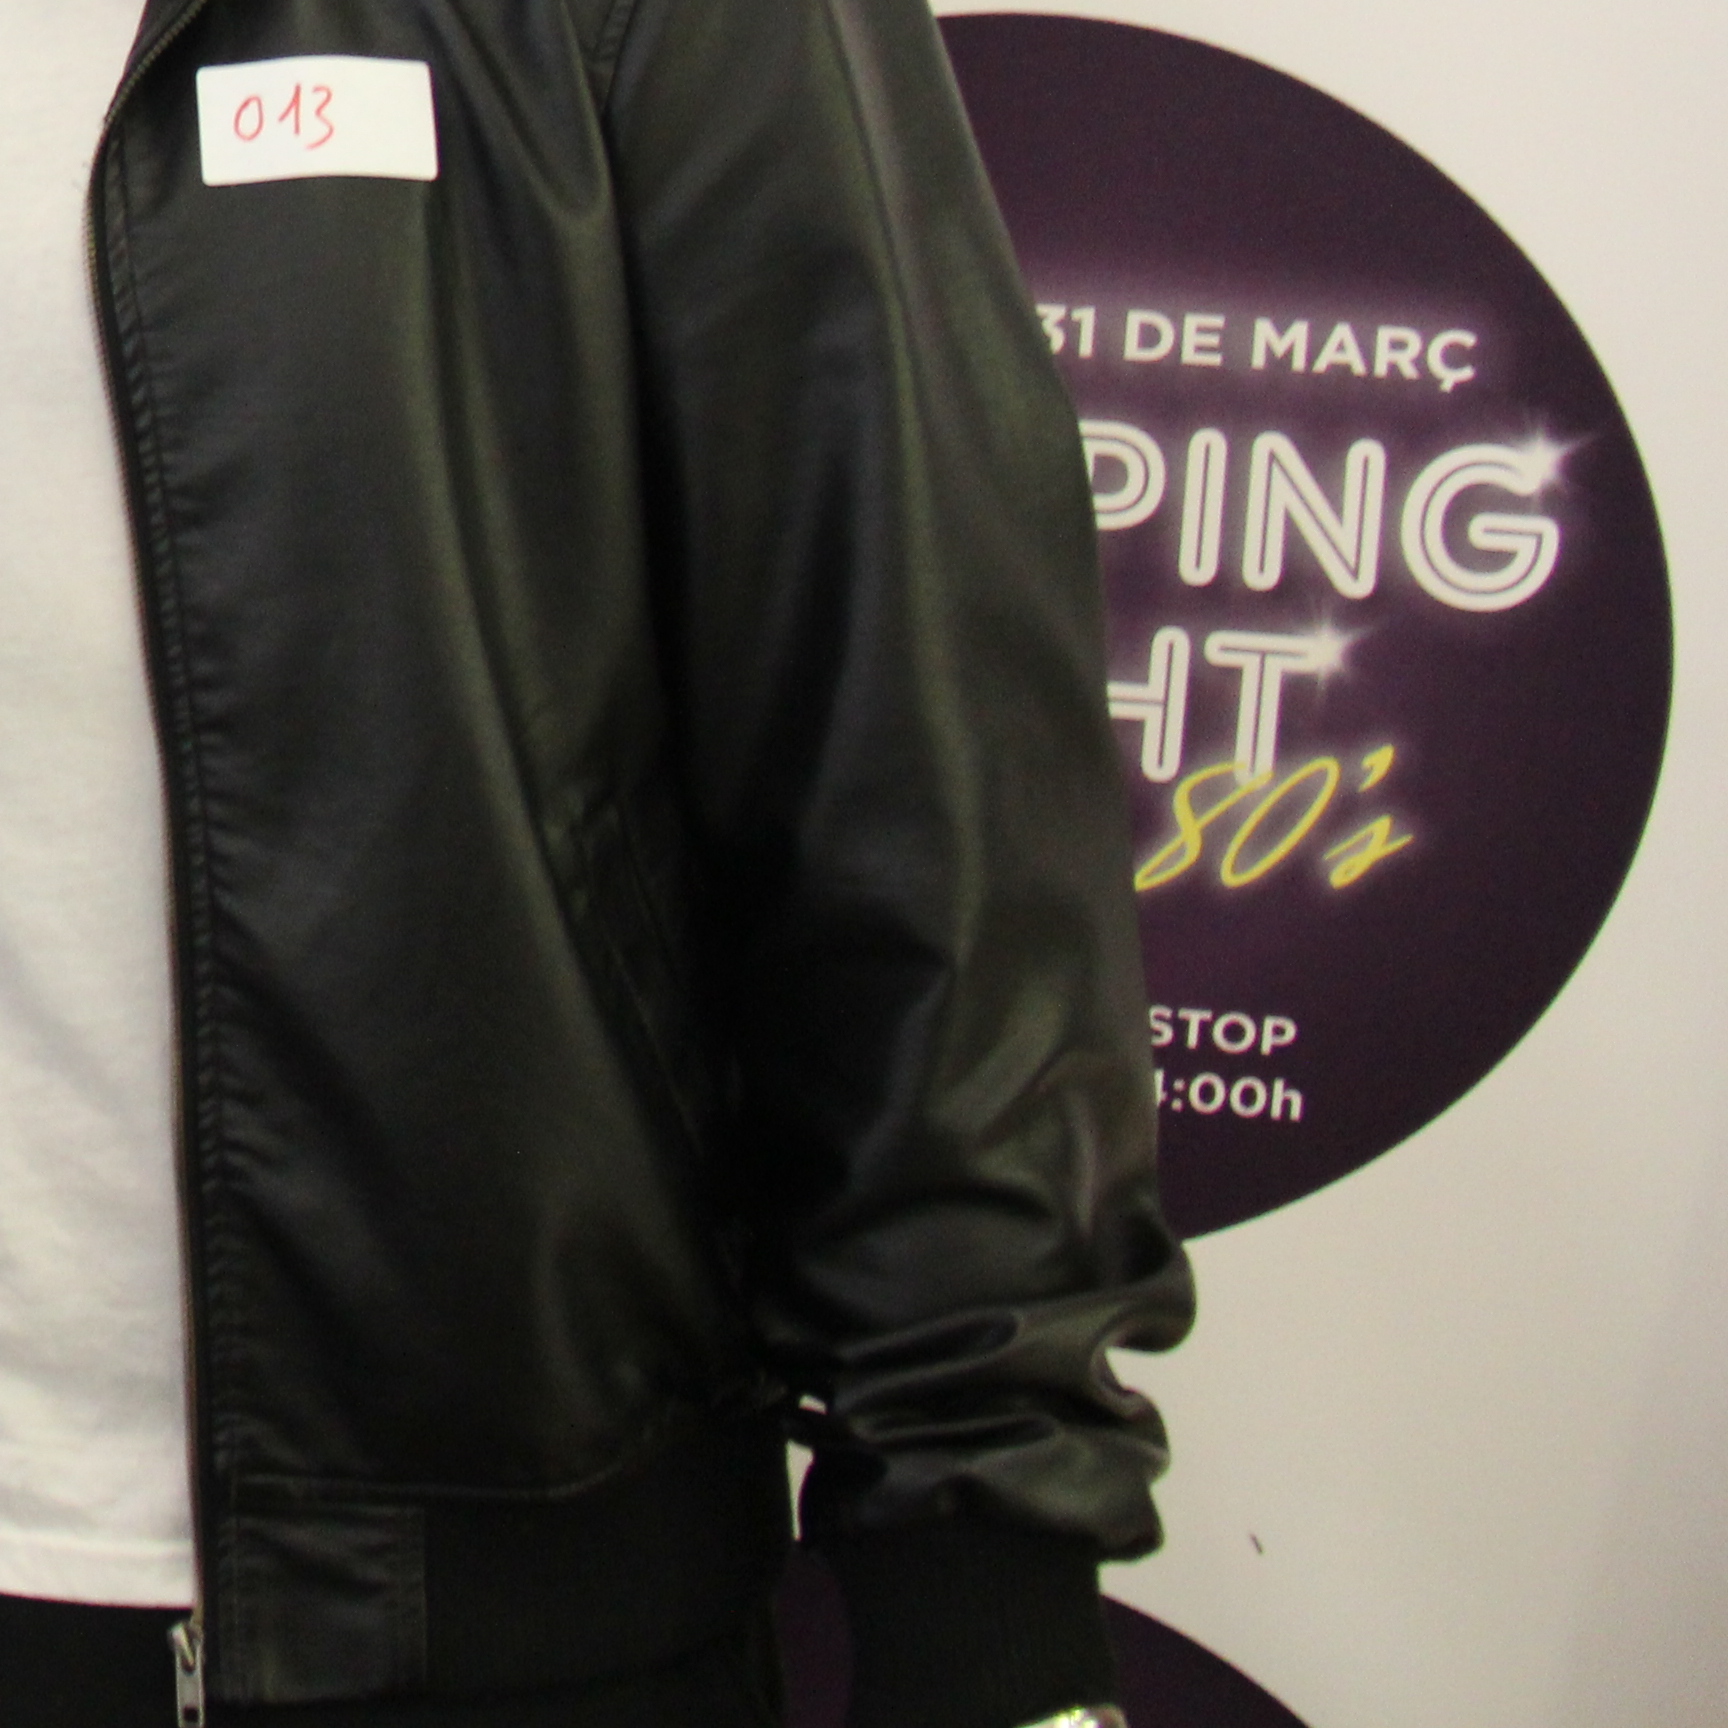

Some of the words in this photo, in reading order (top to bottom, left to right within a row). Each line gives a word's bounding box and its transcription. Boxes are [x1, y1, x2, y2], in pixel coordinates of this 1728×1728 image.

[233, 81, 335, 150] 013
[1123, 309, 1226, 367] DE
[1251, 318, 1477, 392] MARÇ
[1078, 418, 1560, 613] PING
[1134, 744, 1414, 893] 80's
[1149, 1005, 1298, 1056] STOP
[1155, 1068, 1305, 1123] :00h
